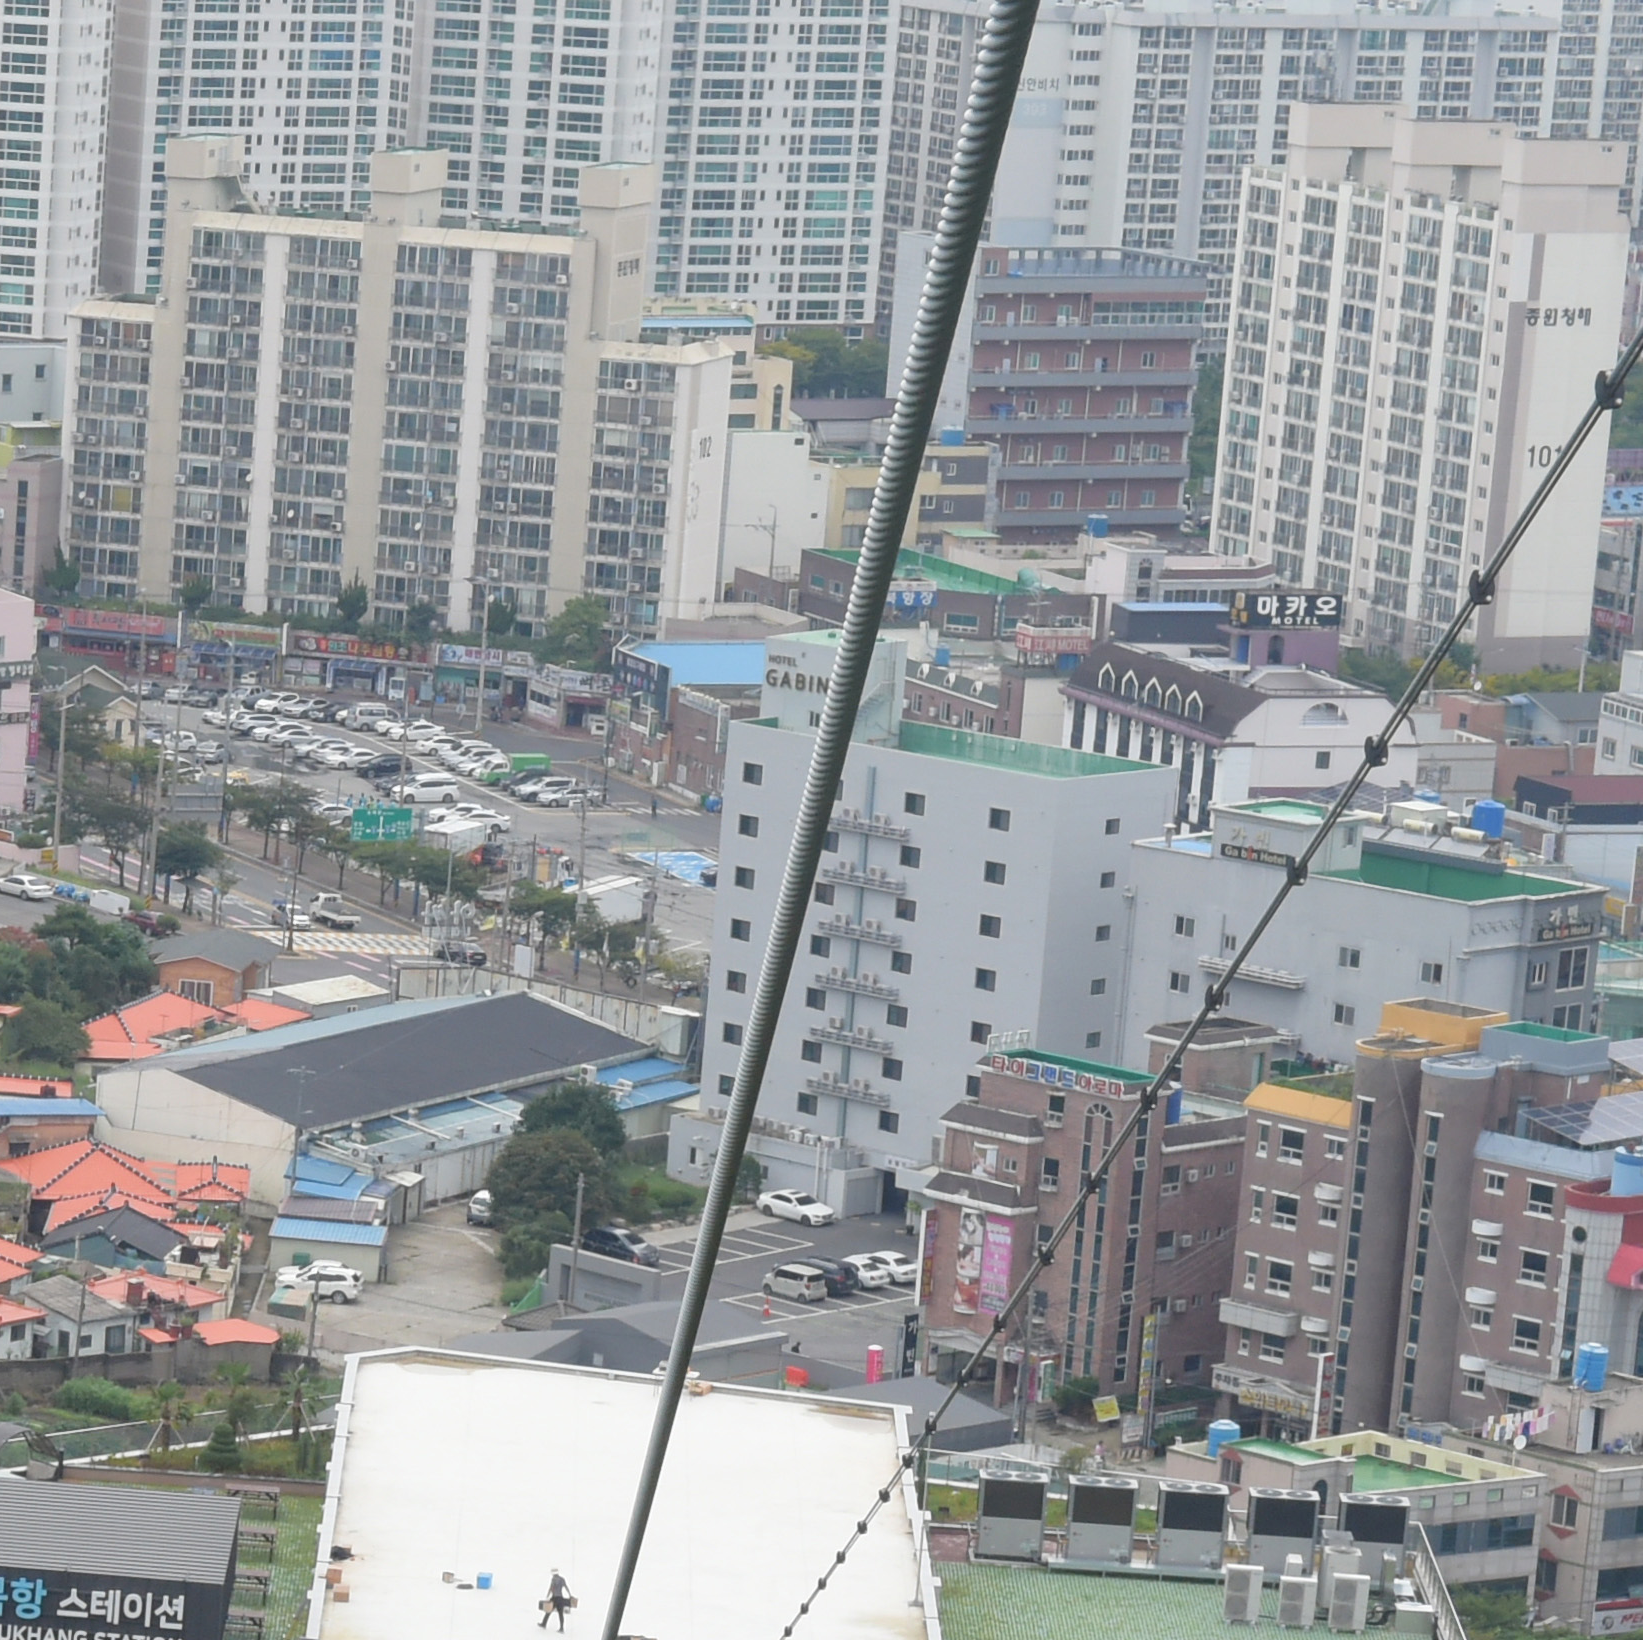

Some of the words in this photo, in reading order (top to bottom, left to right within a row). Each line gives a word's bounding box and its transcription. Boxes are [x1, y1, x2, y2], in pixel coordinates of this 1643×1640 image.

[1527, 444, 1563, 468] 10
[1256, 594, 1338, 617] 마카오
[1271, 616, 1320, 625] MOTEL
[768, 653, 798, 668] HOTEL
[765, 668, 831, 695] GABIN
[56, 1587, 186, 1631] 스테이션
